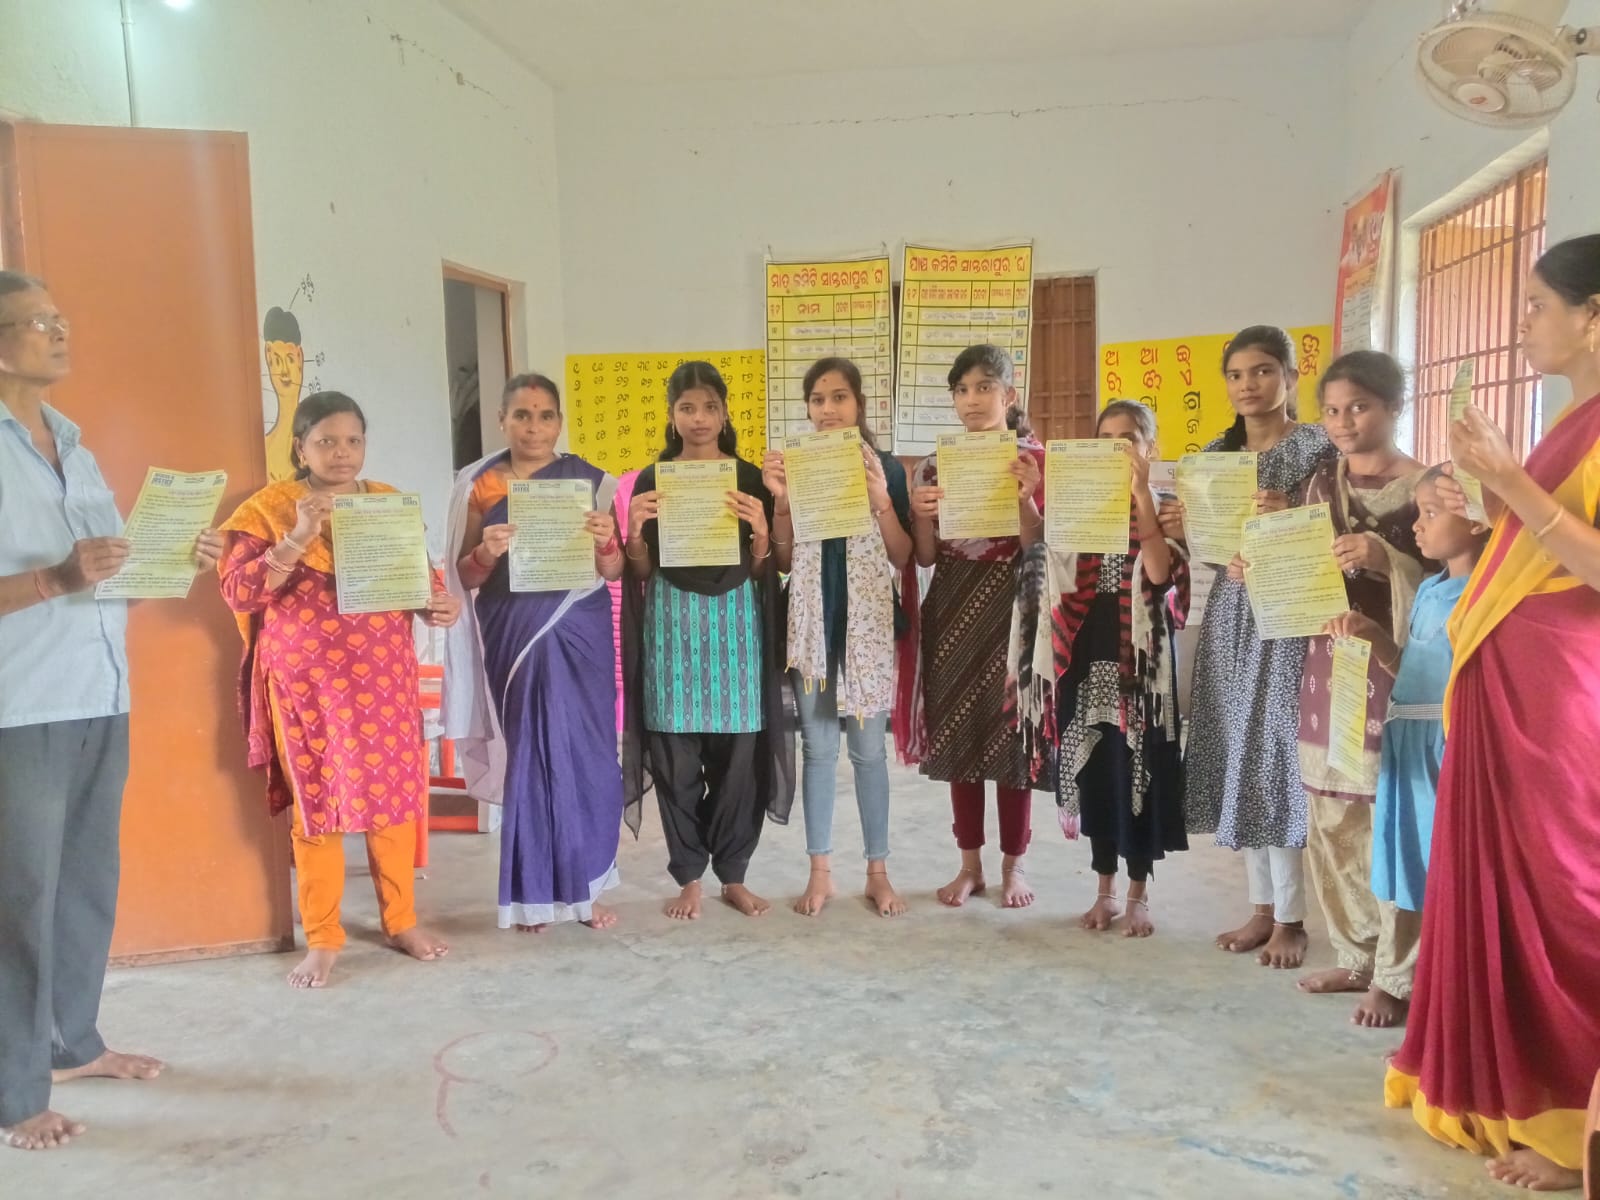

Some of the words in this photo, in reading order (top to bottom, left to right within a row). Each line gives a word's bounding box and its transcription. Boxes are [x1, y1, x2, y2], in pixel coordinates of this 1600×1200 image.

[931, 254, 957, 272] କମିଟି
[797, 303, 820, 315] ନାମ
[1105, 350, 1120, 366] ଅ
[1140, 347, 1158, 365] ଆ
